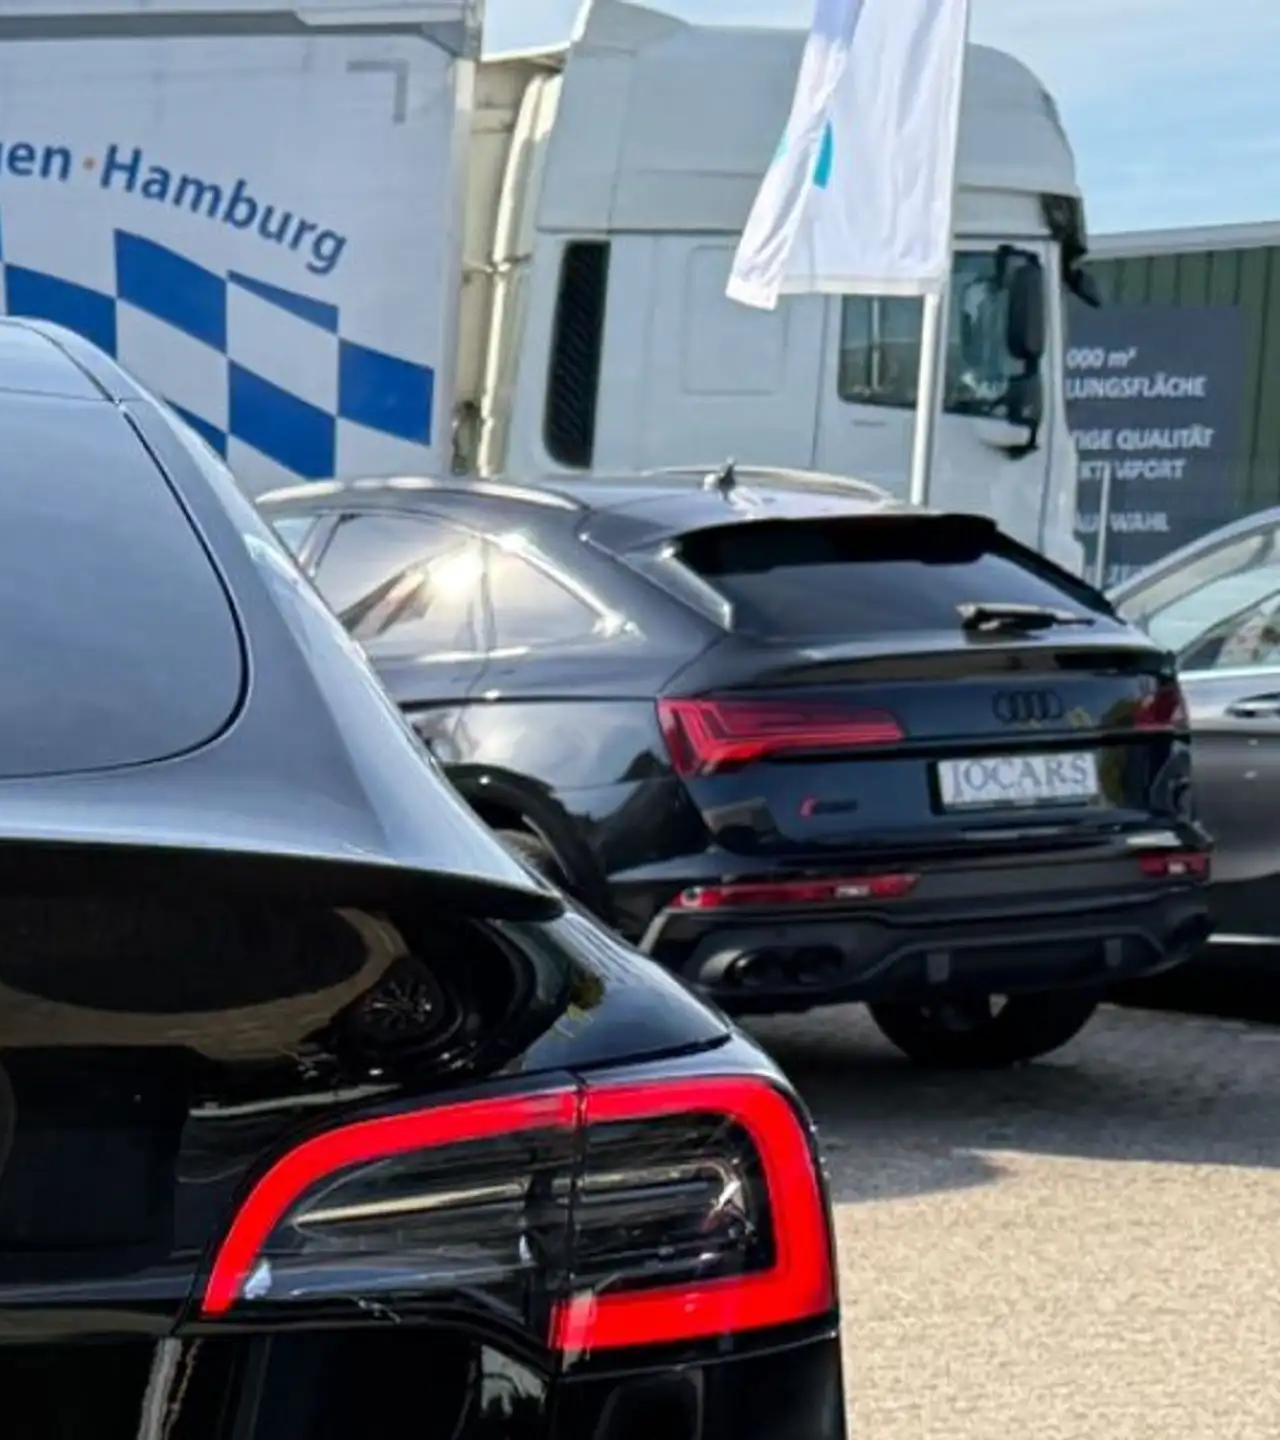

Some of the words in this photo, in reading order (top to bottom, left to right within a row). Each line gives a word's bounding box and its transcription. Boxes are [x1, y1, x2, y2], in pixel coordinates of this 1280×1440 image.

[99, 143, 348, 277] Hamburg
[1116, 423, 1214, 451] QUALITÄT
[952, 754, 1088, 798] JOCARS
